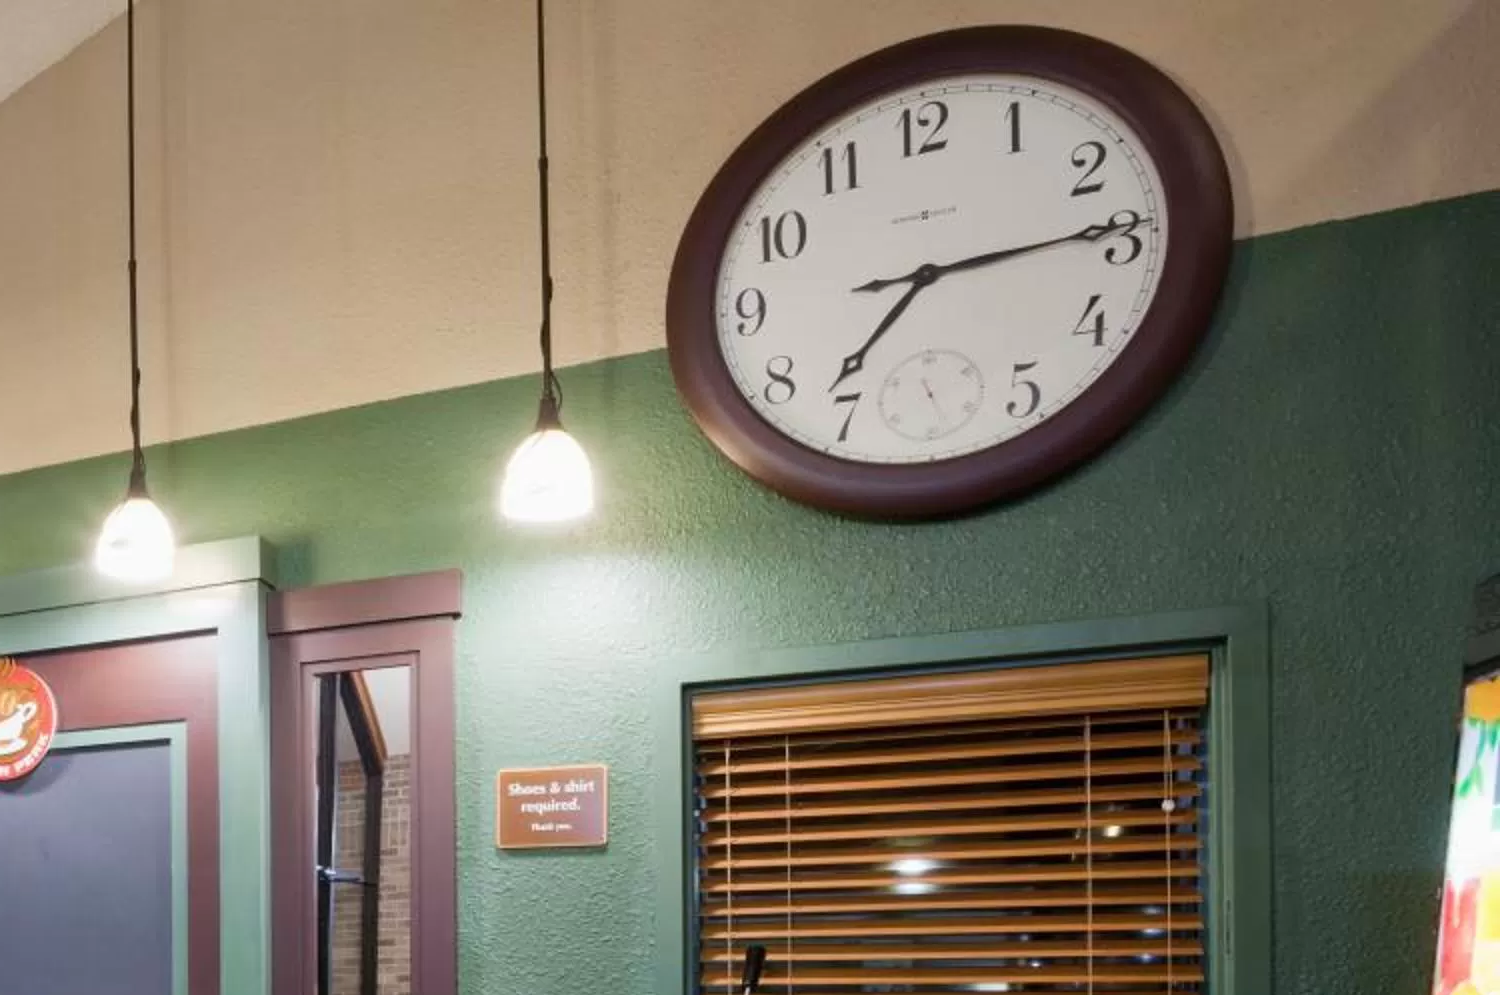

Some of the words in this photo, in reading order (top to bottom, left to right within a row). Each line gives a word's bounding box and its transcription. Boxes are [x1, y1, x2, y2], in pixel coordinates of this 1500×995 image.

[896, 101, 949, 157] 12
[1005, 101, 1024, 154] 1
[819, 141, 861, 194] 11
[1070, 141, 1107, 196] 2
[759, 210, 807, 263] 10
[1104, 209, 1142, 265] 3
[735, 288, 766, 336] 9
[1072, 294, 1108, 347] 4
[764, 355, 795, 404] 8
[1006, 361, 1040, 417] 5
[834, 392, 861, 442] 7
[521, 798, 581, 816] required.
[564, 779, 595, 793] shirt
